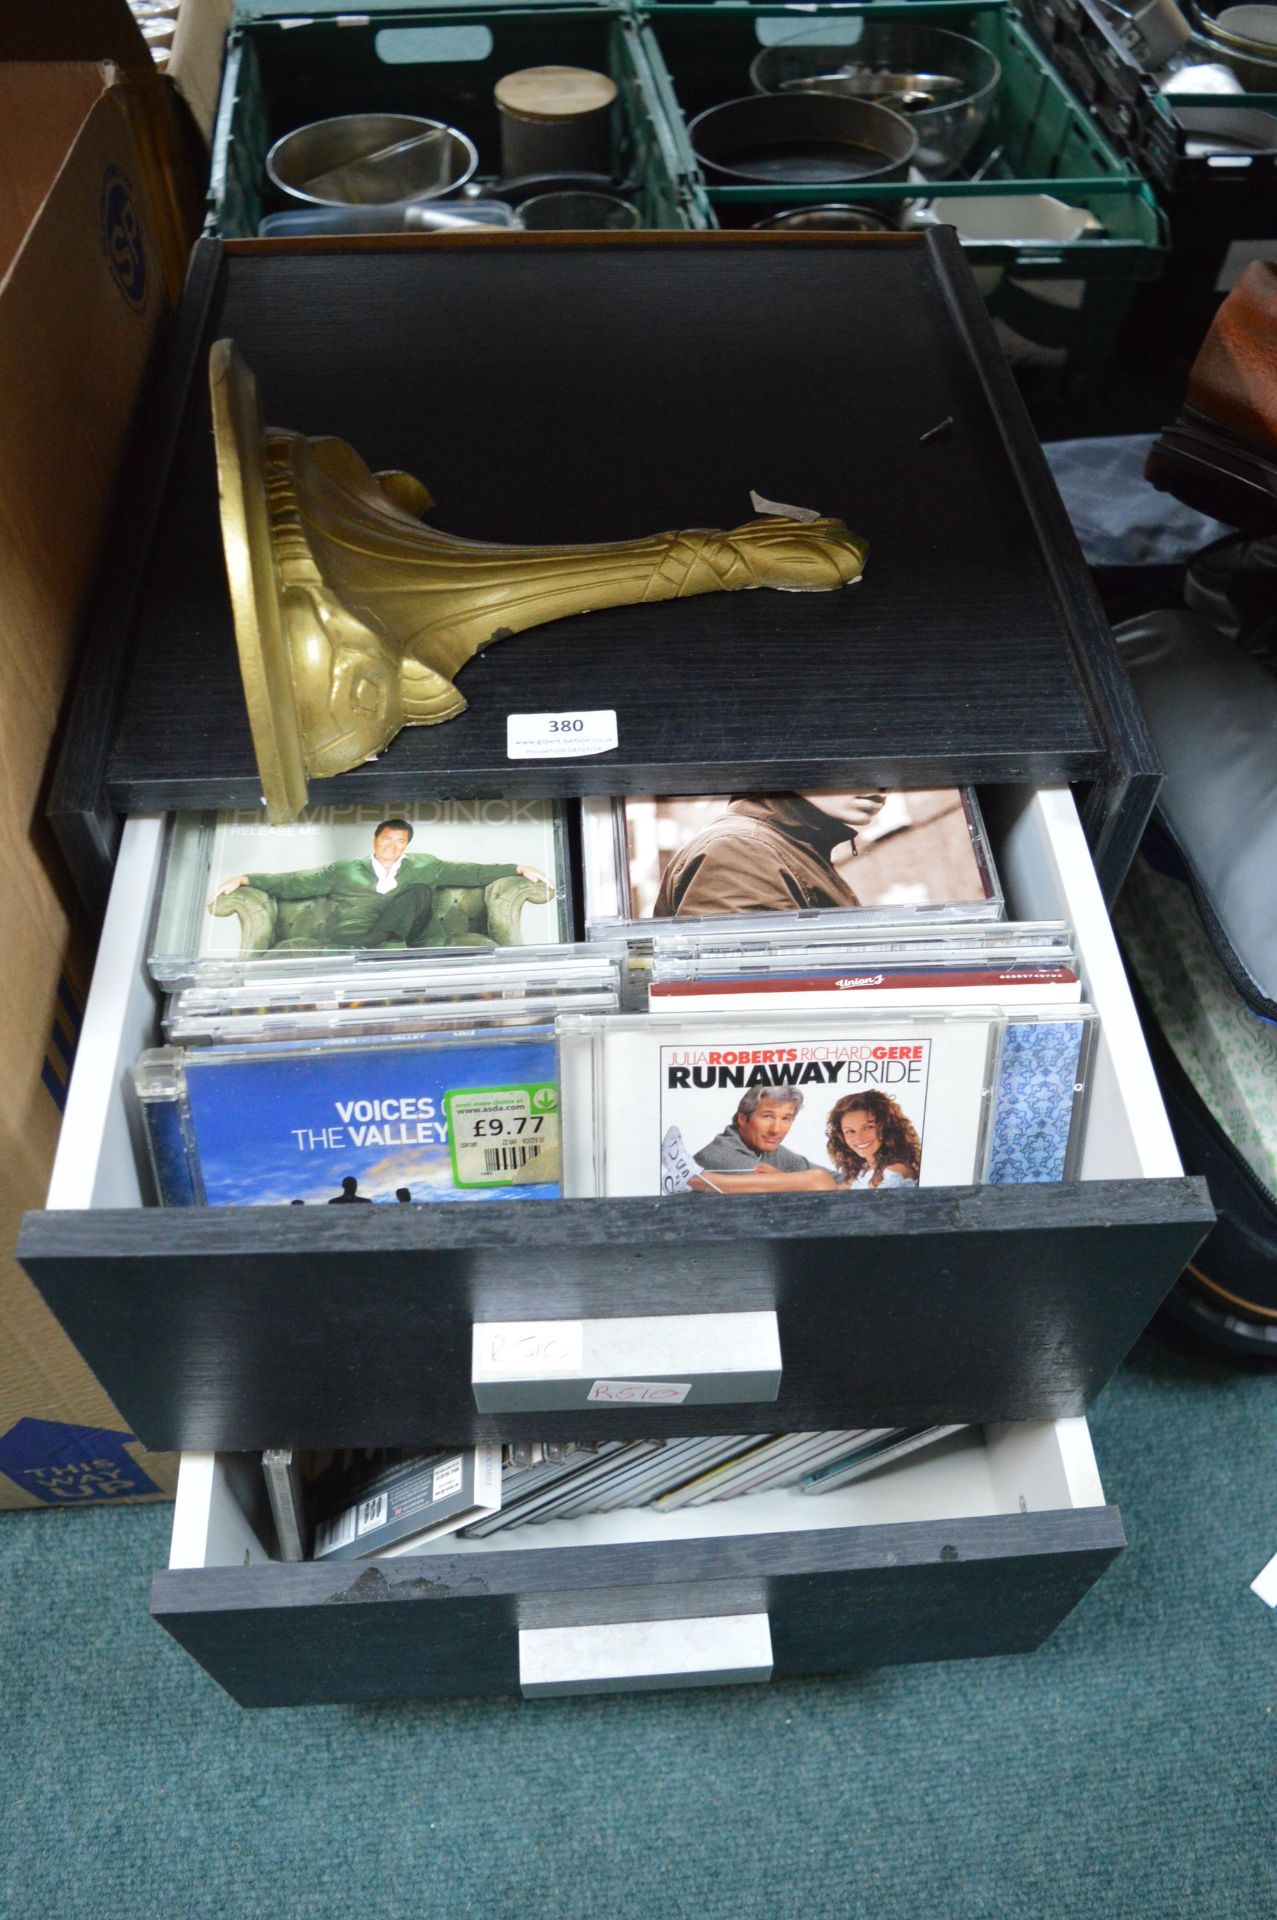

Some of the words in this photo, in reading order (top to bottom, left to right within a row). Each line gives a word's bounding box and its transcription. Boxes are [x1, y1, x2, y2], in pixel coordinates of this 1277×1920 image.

[548, 719, 584, 732] 380
[232, 799, 541, 826] HMPERDINCK
[231, 826, 296, 836] RELEASE
[300, 826, 320, 835] ME
[835, 977, 874, 989] Union
[668, 1060, 847, 1089] RUNAWAY
[846, 1060, 922, 1083] BRIDE
[334, 1097, 436, 1124] VOICES
[456, 1104, 525, 1115] www.asda.com
[290, 1126, 346, 1151] THE
[347, 1121, 448, 1148] VALLEY
[473, 1116, 544, 1137] £9.77
[23, 1458, 115, 1478] THIS
[36, 1468, 121, 1487] WAY
[50, 1480, 135, 1498] UP
